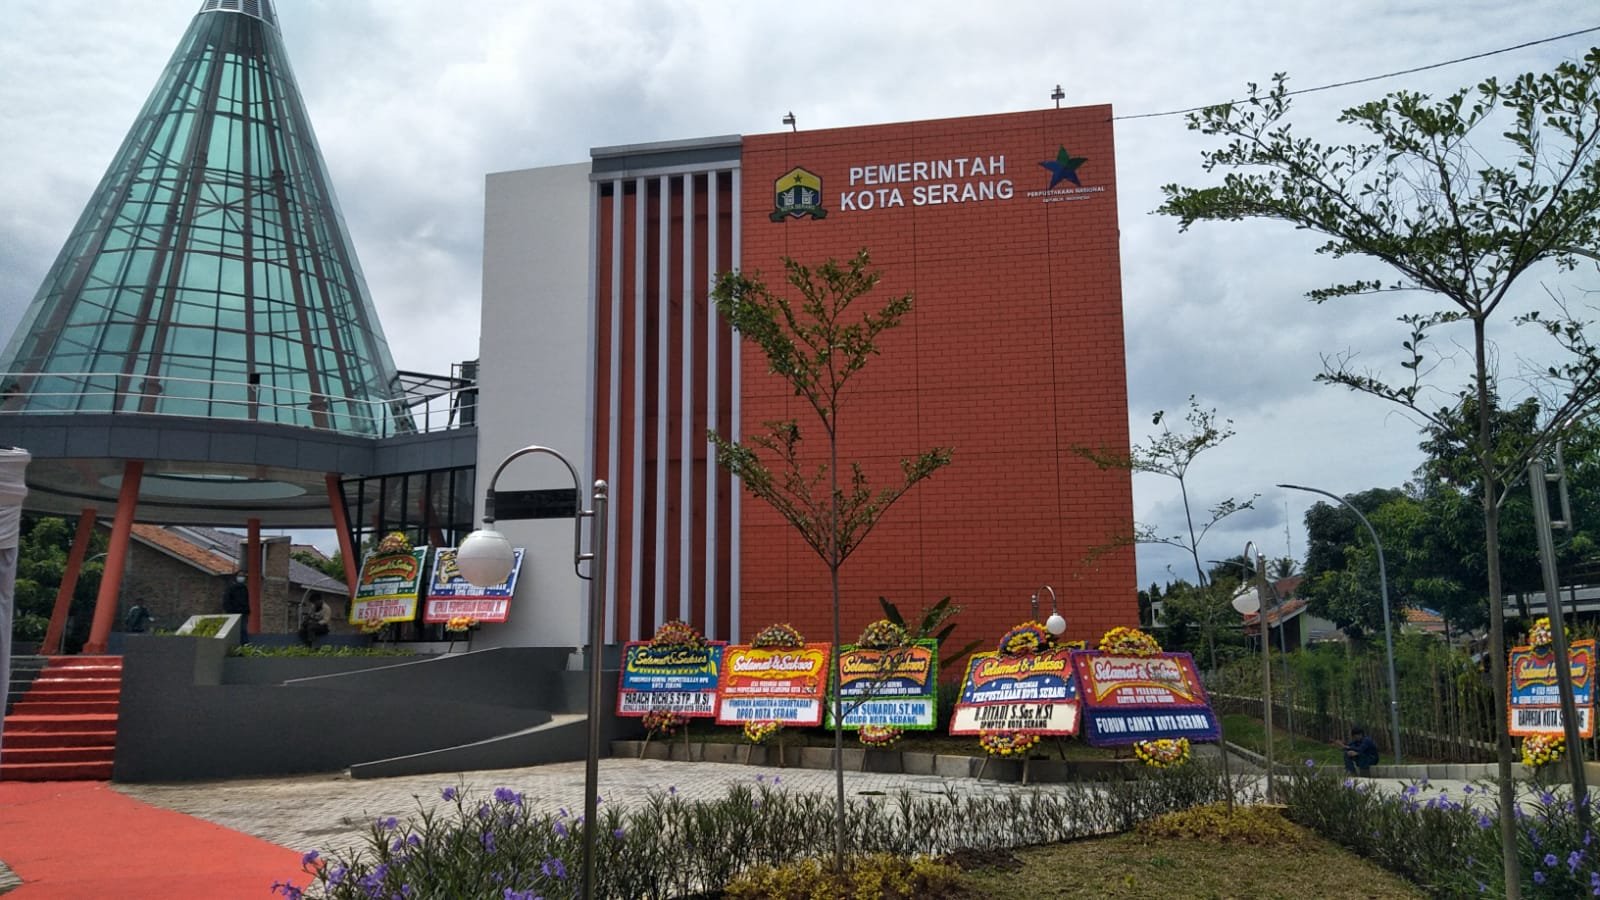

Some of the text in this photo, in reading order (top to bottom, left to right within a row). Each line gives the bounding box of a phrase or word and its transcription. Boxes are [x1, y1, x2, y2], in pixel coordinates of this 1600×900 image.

[849, 155, 1005, 186] PEMERINTAH
[840, 179, 1014, 211] KOTA SERANG
[1027, 186, 1104, 197] PERPUSTAKAAN NASIONAL
[635, 651, 667, 665] Selamat
[676, 651, 707, 665] Sukses
[734, 656, 772, 672] Selamat
[780, 656, 814, 671] Sukses
[844, 655, 881, 673] Selamat
[980, 655, 1065, 676] Selamat & Sukses
[1095, 662, 1138, 681] Selamat
[1139, 664, 1149, 680] &
[971, 687, 1066, 702] PERPUSTAKAAN KOTA SERANG
[754, 708, 770, 719] KOTA
[772, 708, 798, 719] SERANG
[1543, 710, 1558, 728] KOTA
[1007, 720, 1023, 729] KOTA
[1024, 720, 1048, 729] SERANG
[1095, 714, 1209, 734] FORUM CAMAT KOTA SERANG
